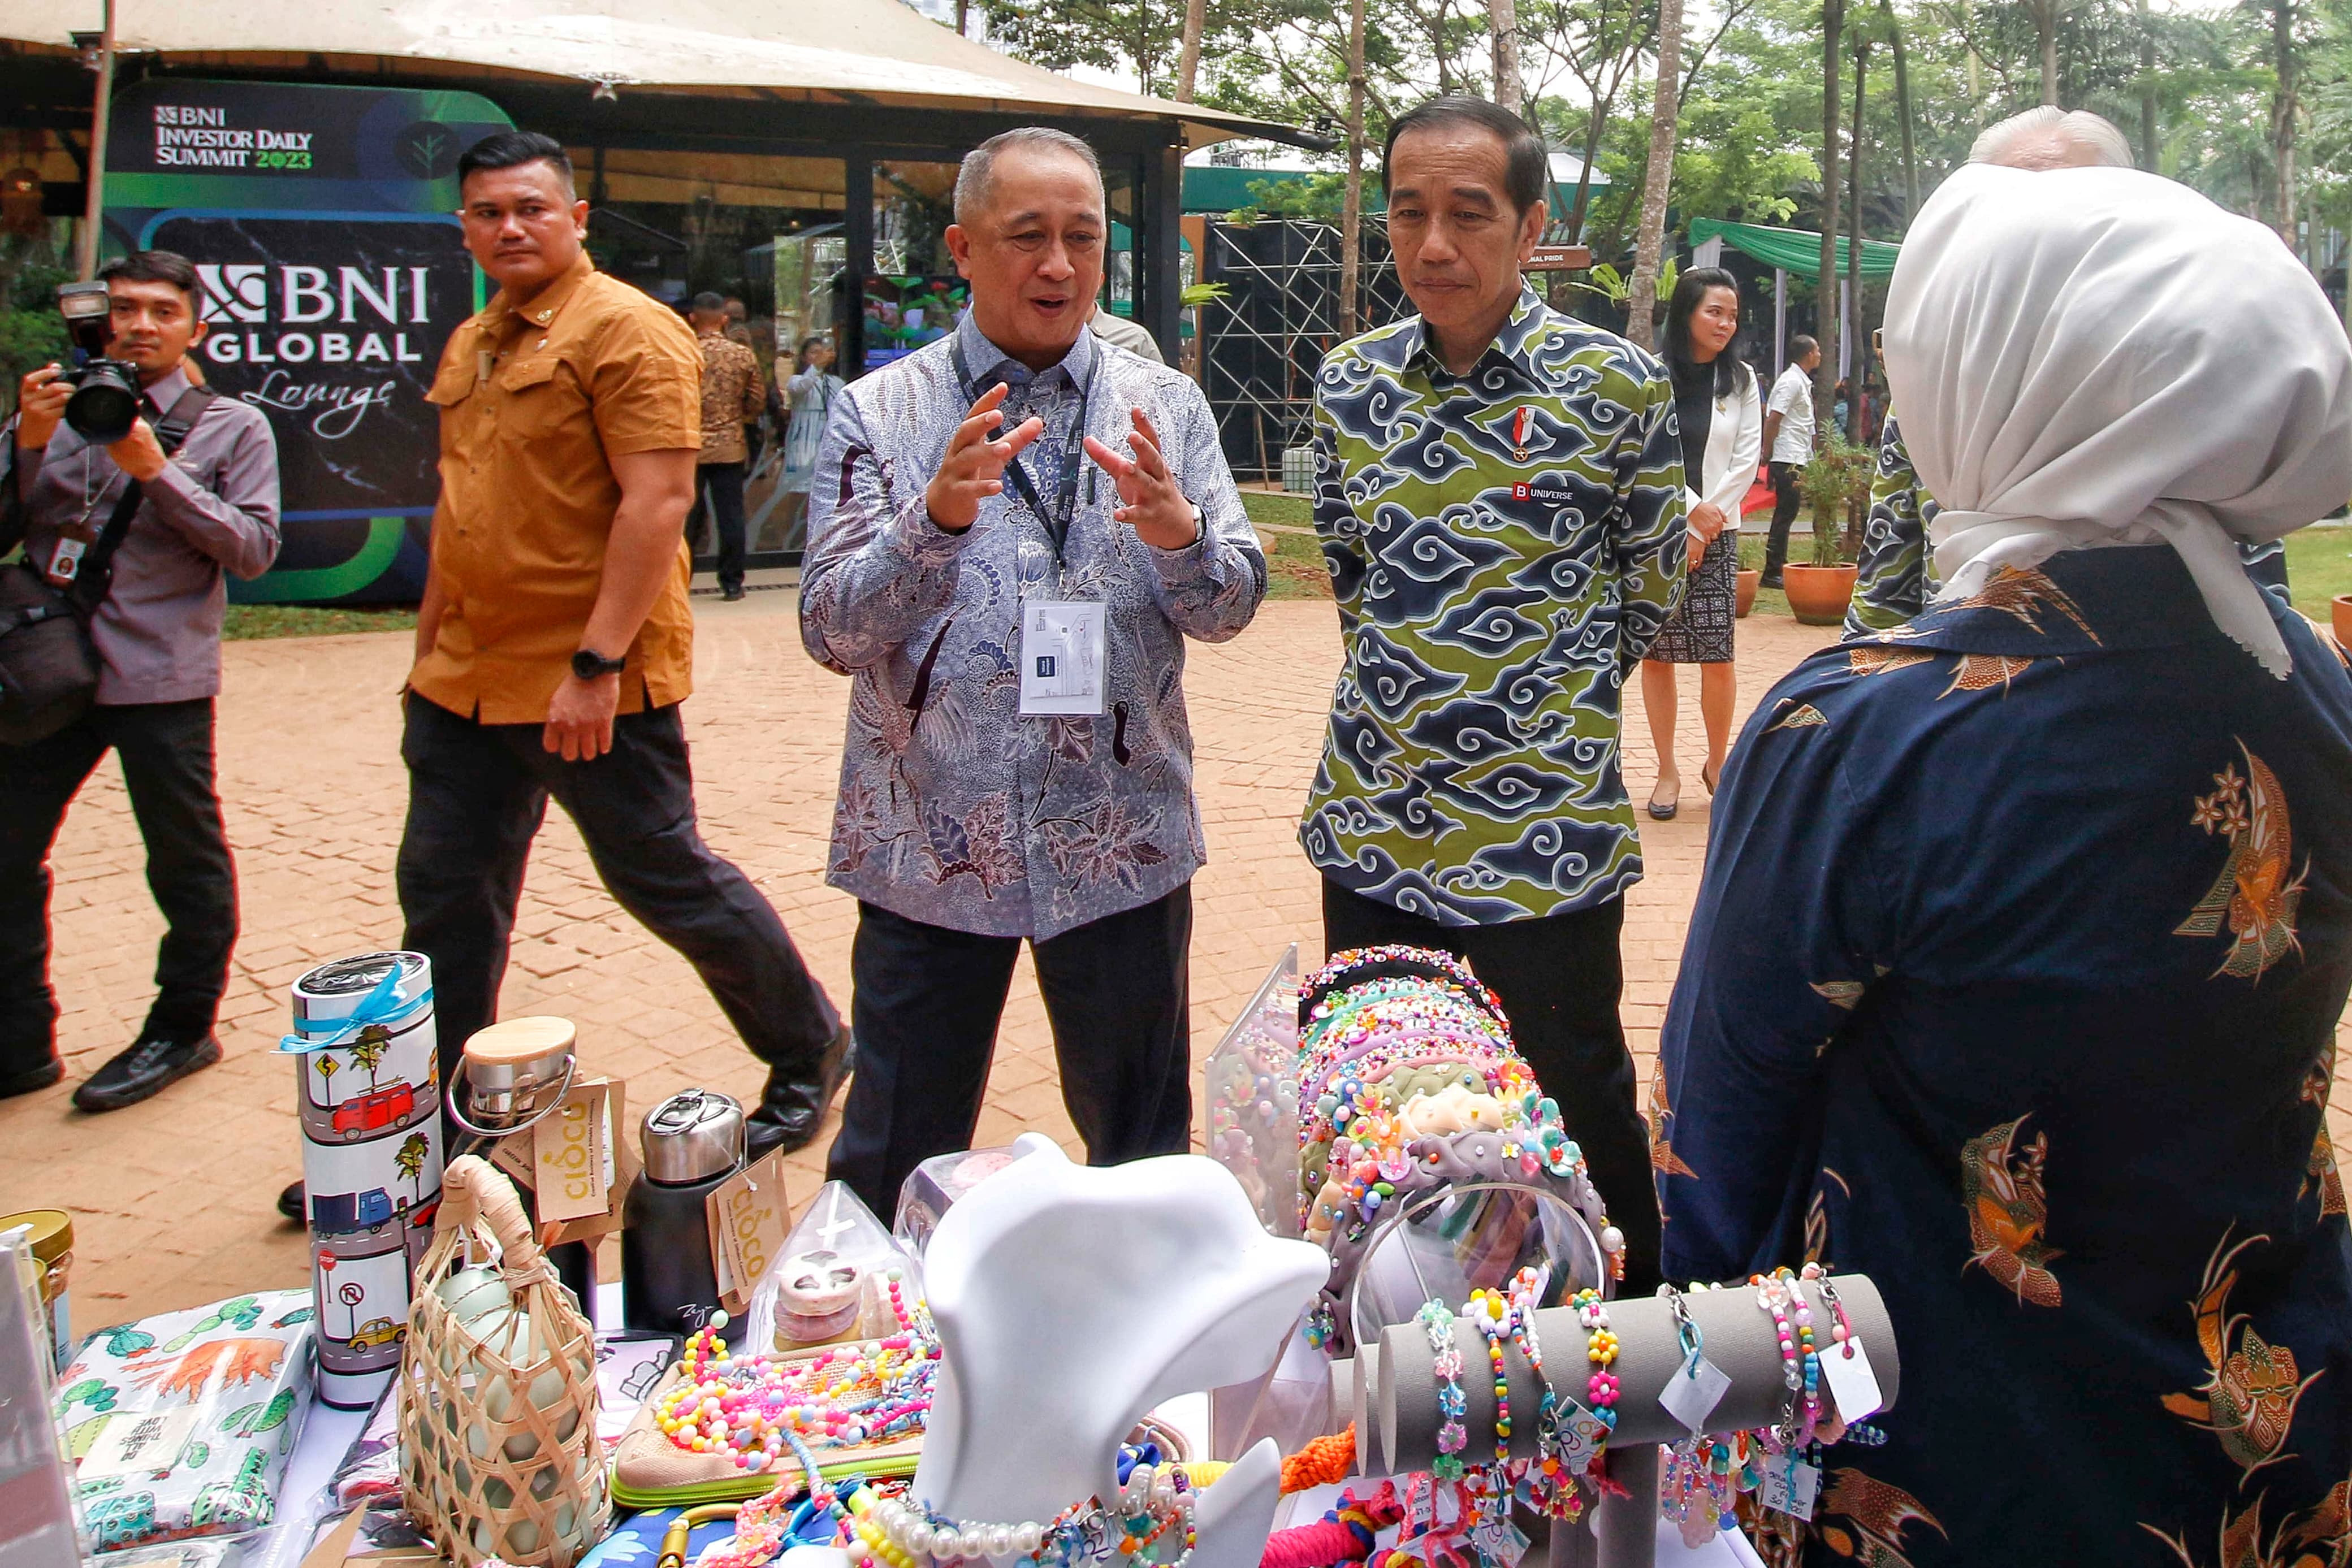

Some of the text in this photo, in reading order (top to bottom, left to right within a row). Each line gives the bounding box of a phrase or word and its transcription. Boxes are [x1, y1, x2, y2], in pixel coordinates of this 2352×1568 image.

[179, 106, 226, 126] BNI
[157, 126, 313, 151] INVESTOR DAILY
[155, 148, 313, 170] SUMMIT 2023
[280, 266, 430, 324] BNI
[206, 333, 422, 363] GLOBAL
[240, 369, 396, 440] Lounge
[1516, 485, 1573, 500] B UNIVERSE
[126, 1441, 147, 1453] ALL
